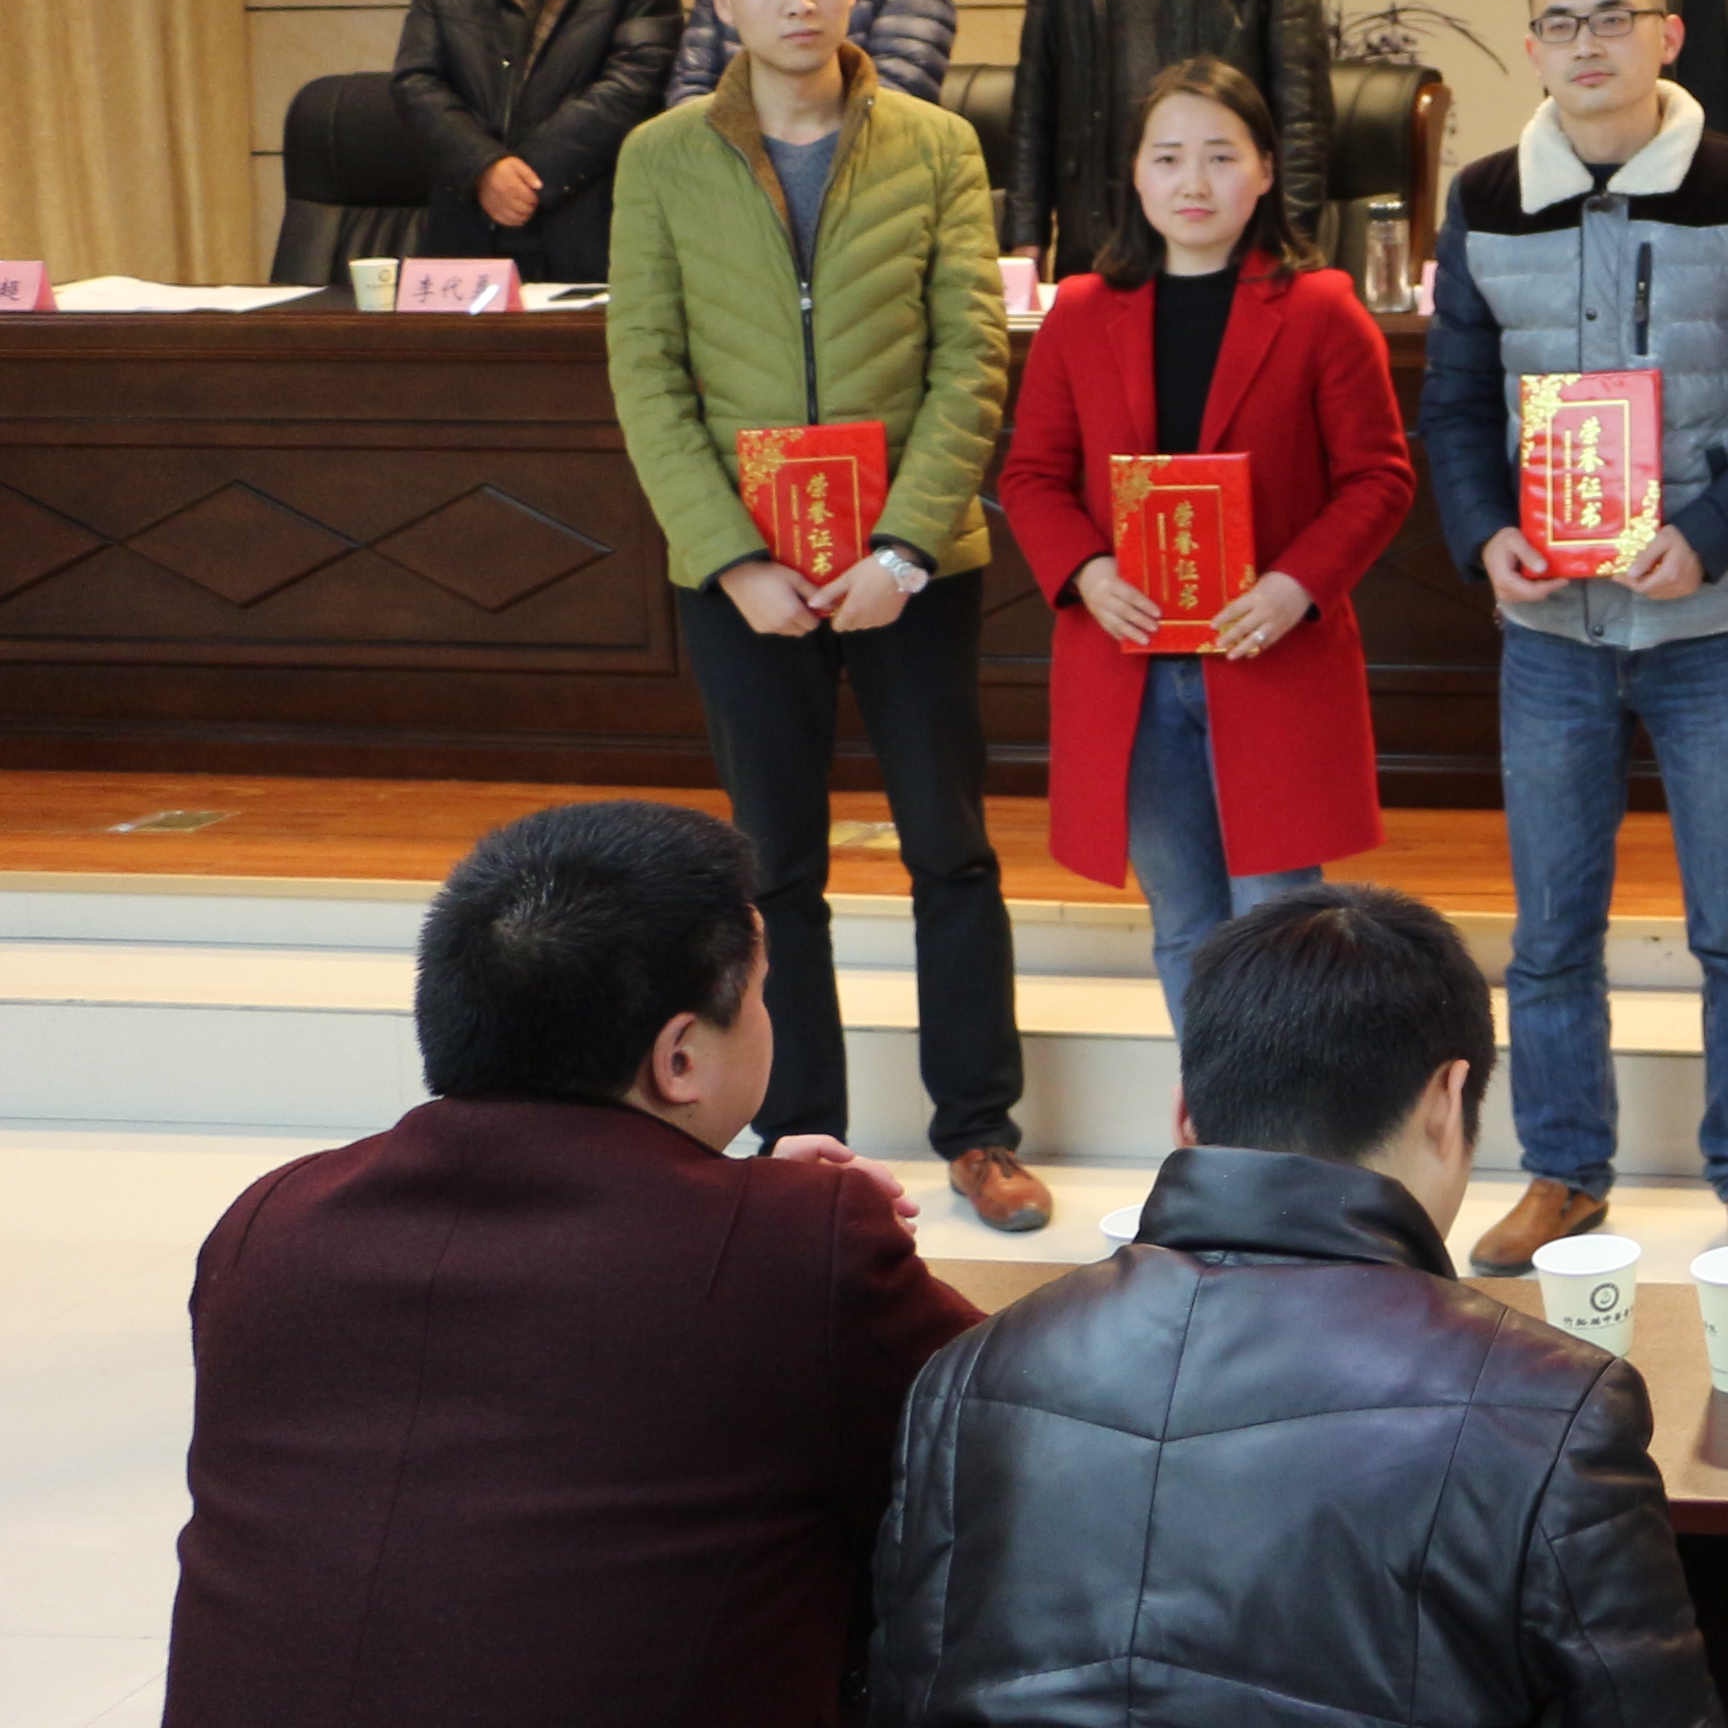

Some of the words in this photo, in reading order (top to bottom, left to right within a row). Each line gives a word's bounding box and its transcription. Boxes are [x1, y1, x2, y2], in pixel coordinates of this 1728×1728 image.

[806, 473, 834, 576] 荣誉证书
[1577, 417, 1604, 528] 荣誉证书
[1173, 501, 1199, 609] 荣誉证书
